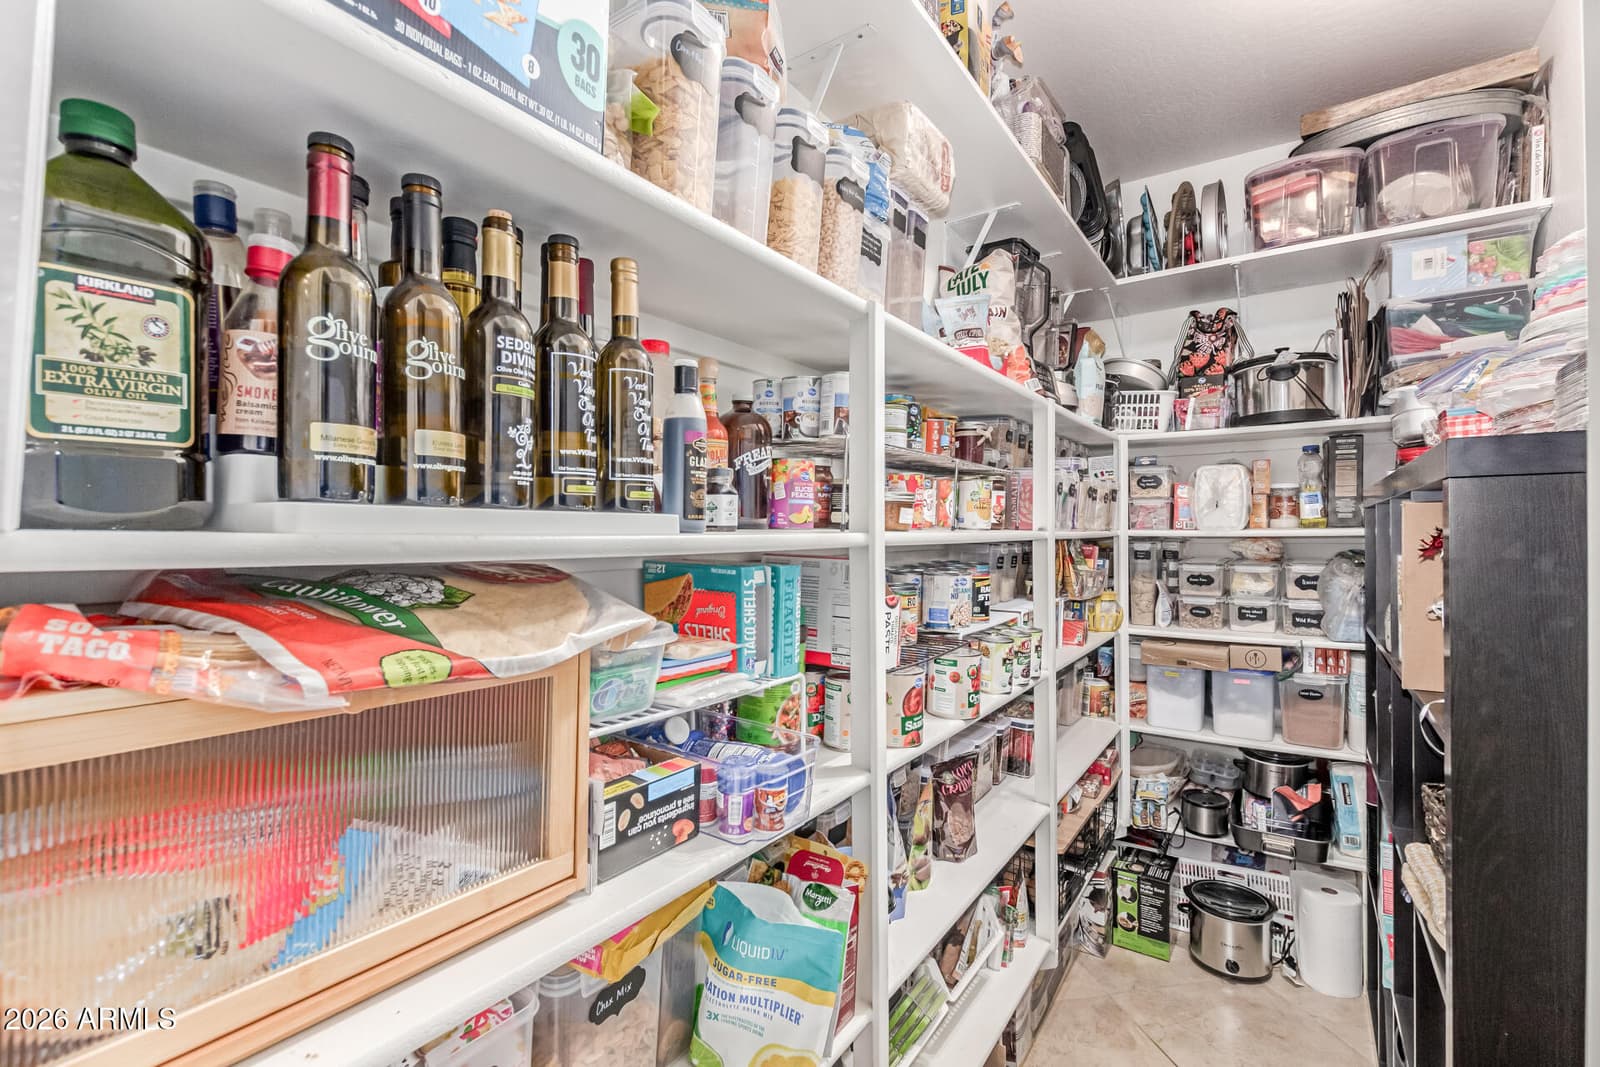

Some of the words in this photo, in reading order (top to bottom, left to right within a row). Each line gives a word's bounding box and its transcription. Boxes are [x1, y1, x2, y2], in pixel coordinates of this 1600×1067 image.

[394, 18, 405, 35] 30
[405, 24, 444, 58] INDIVIDUAL
[444, 47, 464, 69] BAGS
[500, 81, 517, 99] TOTAL
[517, 89, 528, 106] NET
[527, 60, 535, 74] 8
[570, 31, 601, 84] 30
[574, 73, 597, 99] BAGS
[77, 274, 155, 298] KIRKLAND
[956, 271, 990, 296] JULY
[42, 370, 112, 389] EXTRA
[114, 381, 182, 398] VIRGIN
[61, 363, 98, 375] 100%
[103, 368, 168, 383] ITALIAN
[84, 387, 123, 399] OLIVE
[126, 391, 148, 401] OIL
[236, 400, 278, 410] Balsamic
[656, 563, 666, 574] 12
[694, 603, 727, 620] Original
[744, 578, 756, 625] SHELLS
[683, 623, 731, 643] SHELLS
[783, 578, 795, 666] FRAGILE
[38, 633, 131, 662] TACO
[744, 625, 756, 656] TACO
[805, 888, 832, 907] Marzetti
[731, 937, 770, 960] LIQUID
[712, 957, 777, 988] SUGAR-FREE
[616, 982, 632, 1000] Mix
[706, 1010, 720, 1022] 3X
[739, 995, 802, 1026] MULTIPLIER
